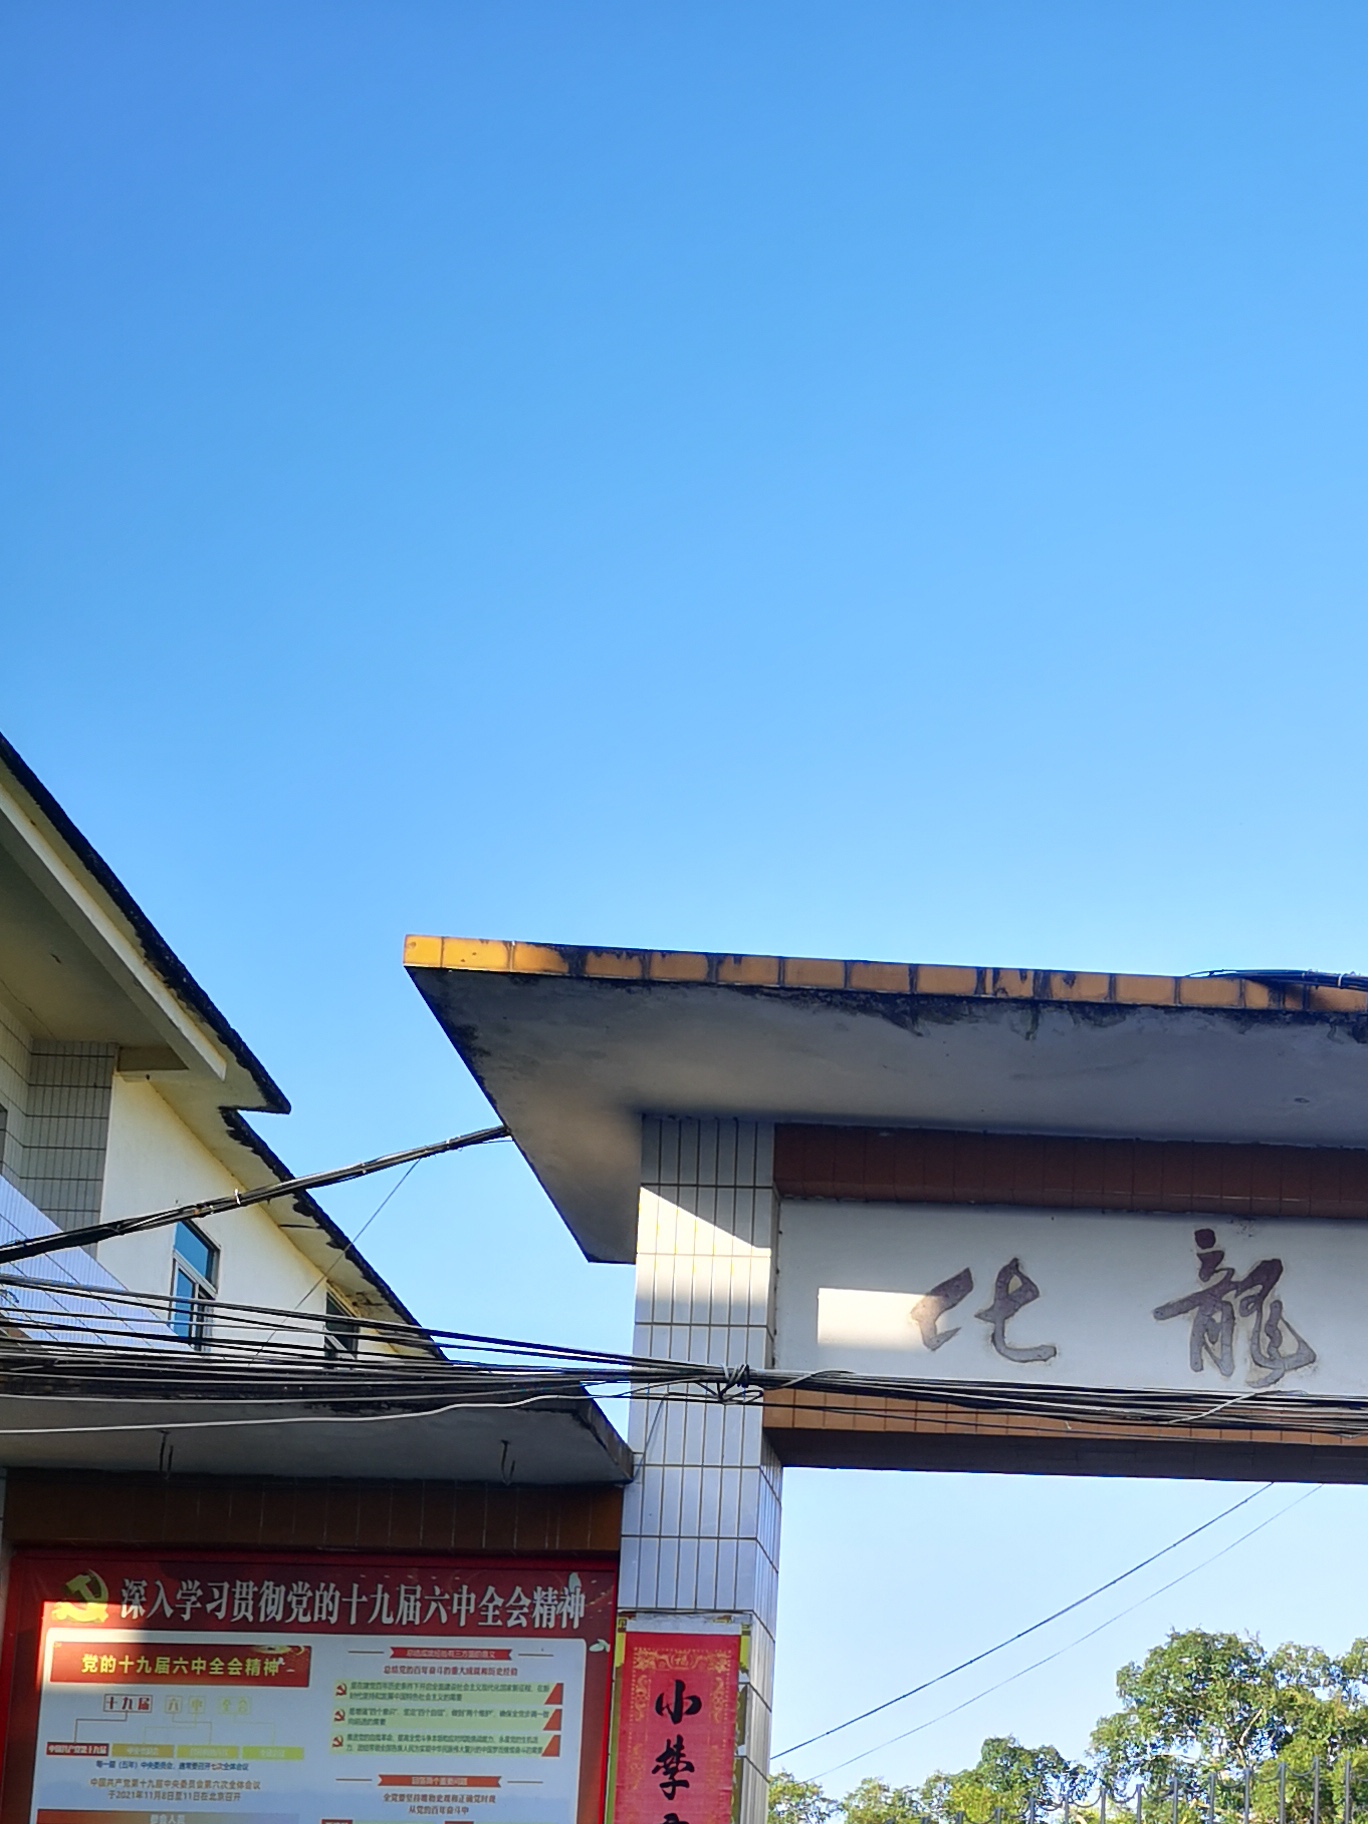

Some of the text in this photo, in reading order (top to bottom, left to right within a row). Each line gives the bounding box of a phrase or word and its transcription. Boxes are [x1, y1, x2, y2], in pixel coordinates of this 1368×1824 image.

[121, 1578, 586, 1629] 深入学习贯彻党的十九届六中全会精神
[81, 1653, 280, 1677] 党的十九届六中全会精神
